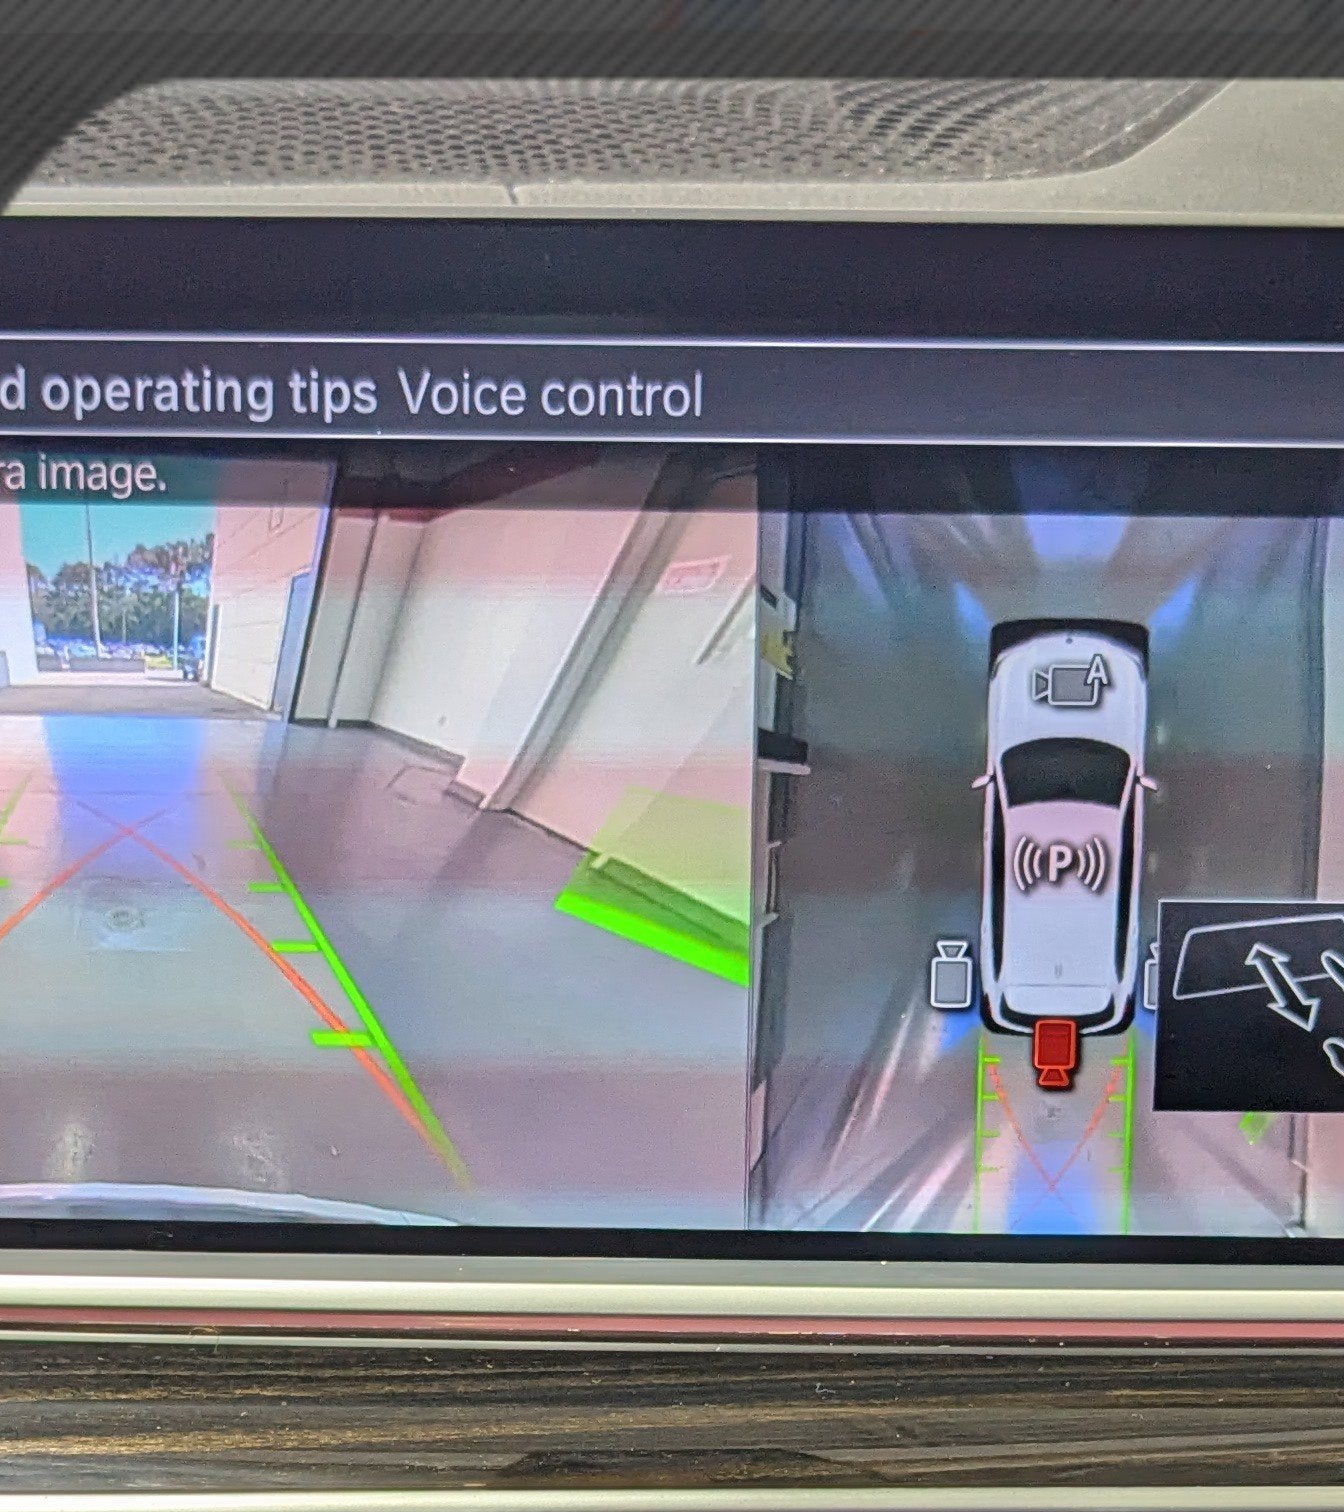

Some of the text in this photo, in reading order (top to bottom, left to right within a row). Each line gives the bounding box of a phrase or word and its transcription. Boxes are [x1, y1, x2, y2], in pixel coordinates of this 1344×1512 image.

[41, 367, 275, 424] operating
[288, 369, 378, 424] tips
[397, 370, 527, 417] Voice
[540, 371, 704, 418] control
[39, 452, 167, 501] image.
